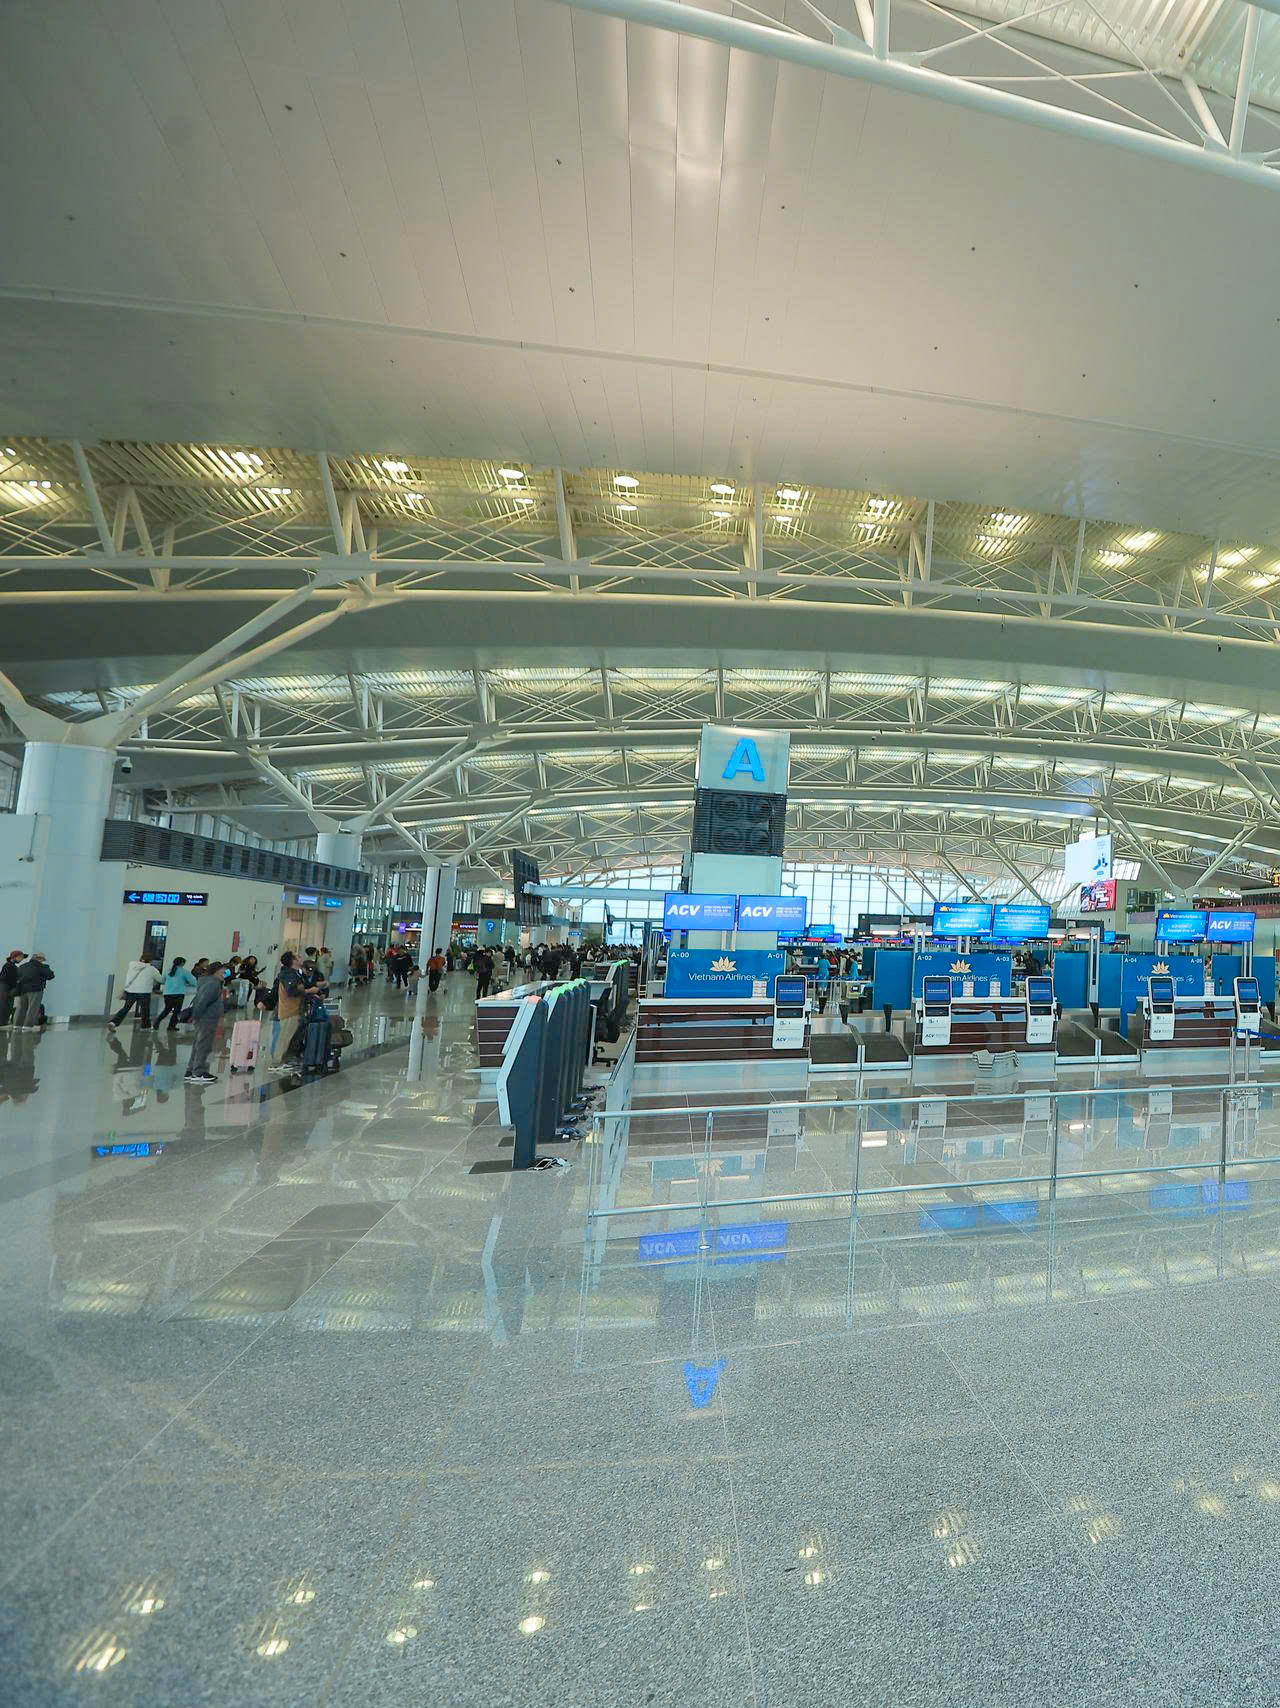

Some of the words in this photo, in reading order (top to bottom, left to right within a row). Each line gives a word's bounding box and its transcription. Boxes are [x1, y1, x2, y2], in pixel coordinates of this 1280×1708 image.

[722, 737, 765, 781] A
[667, 905, 700, 916] ACV
[741, 906, 773, 917] ACV
[1210, 920, 1232, 929] ACV
[671, 951, 690, 959] A-00
[688, 972, 724, 981] Vietnam
[724, 972, 756, 981] Airlines
